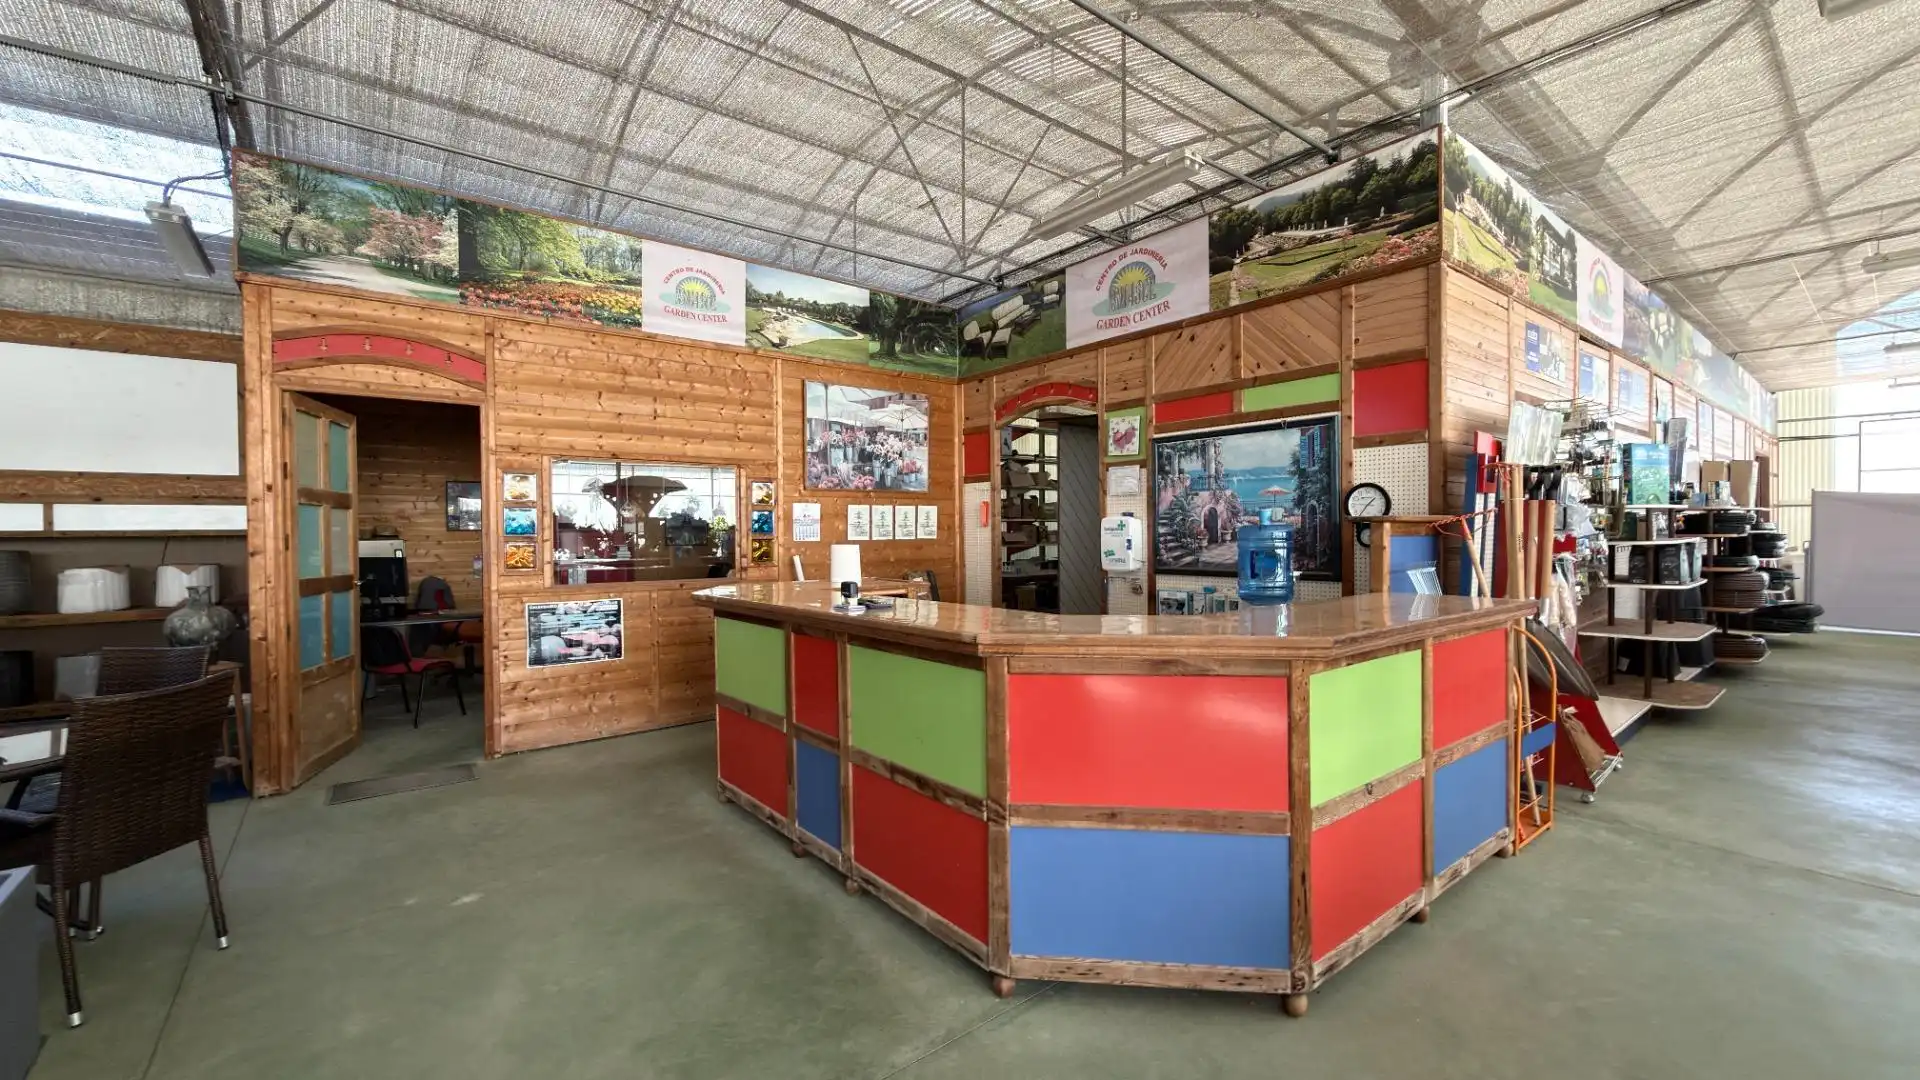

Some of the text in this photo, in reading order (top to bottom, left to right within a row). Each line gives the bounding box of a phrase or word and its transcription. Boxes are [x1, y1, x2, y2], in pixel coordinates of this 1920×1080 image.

[663, 267, 685, 284] CENTRO
[1095, 259, 1117, 292] CENTRO
[1119, 251, 1128, 262] DE
[664, 305, 728, 323] GARDEN CENTER
[1096, 300, 1171, 330] GARDEN CENTER
